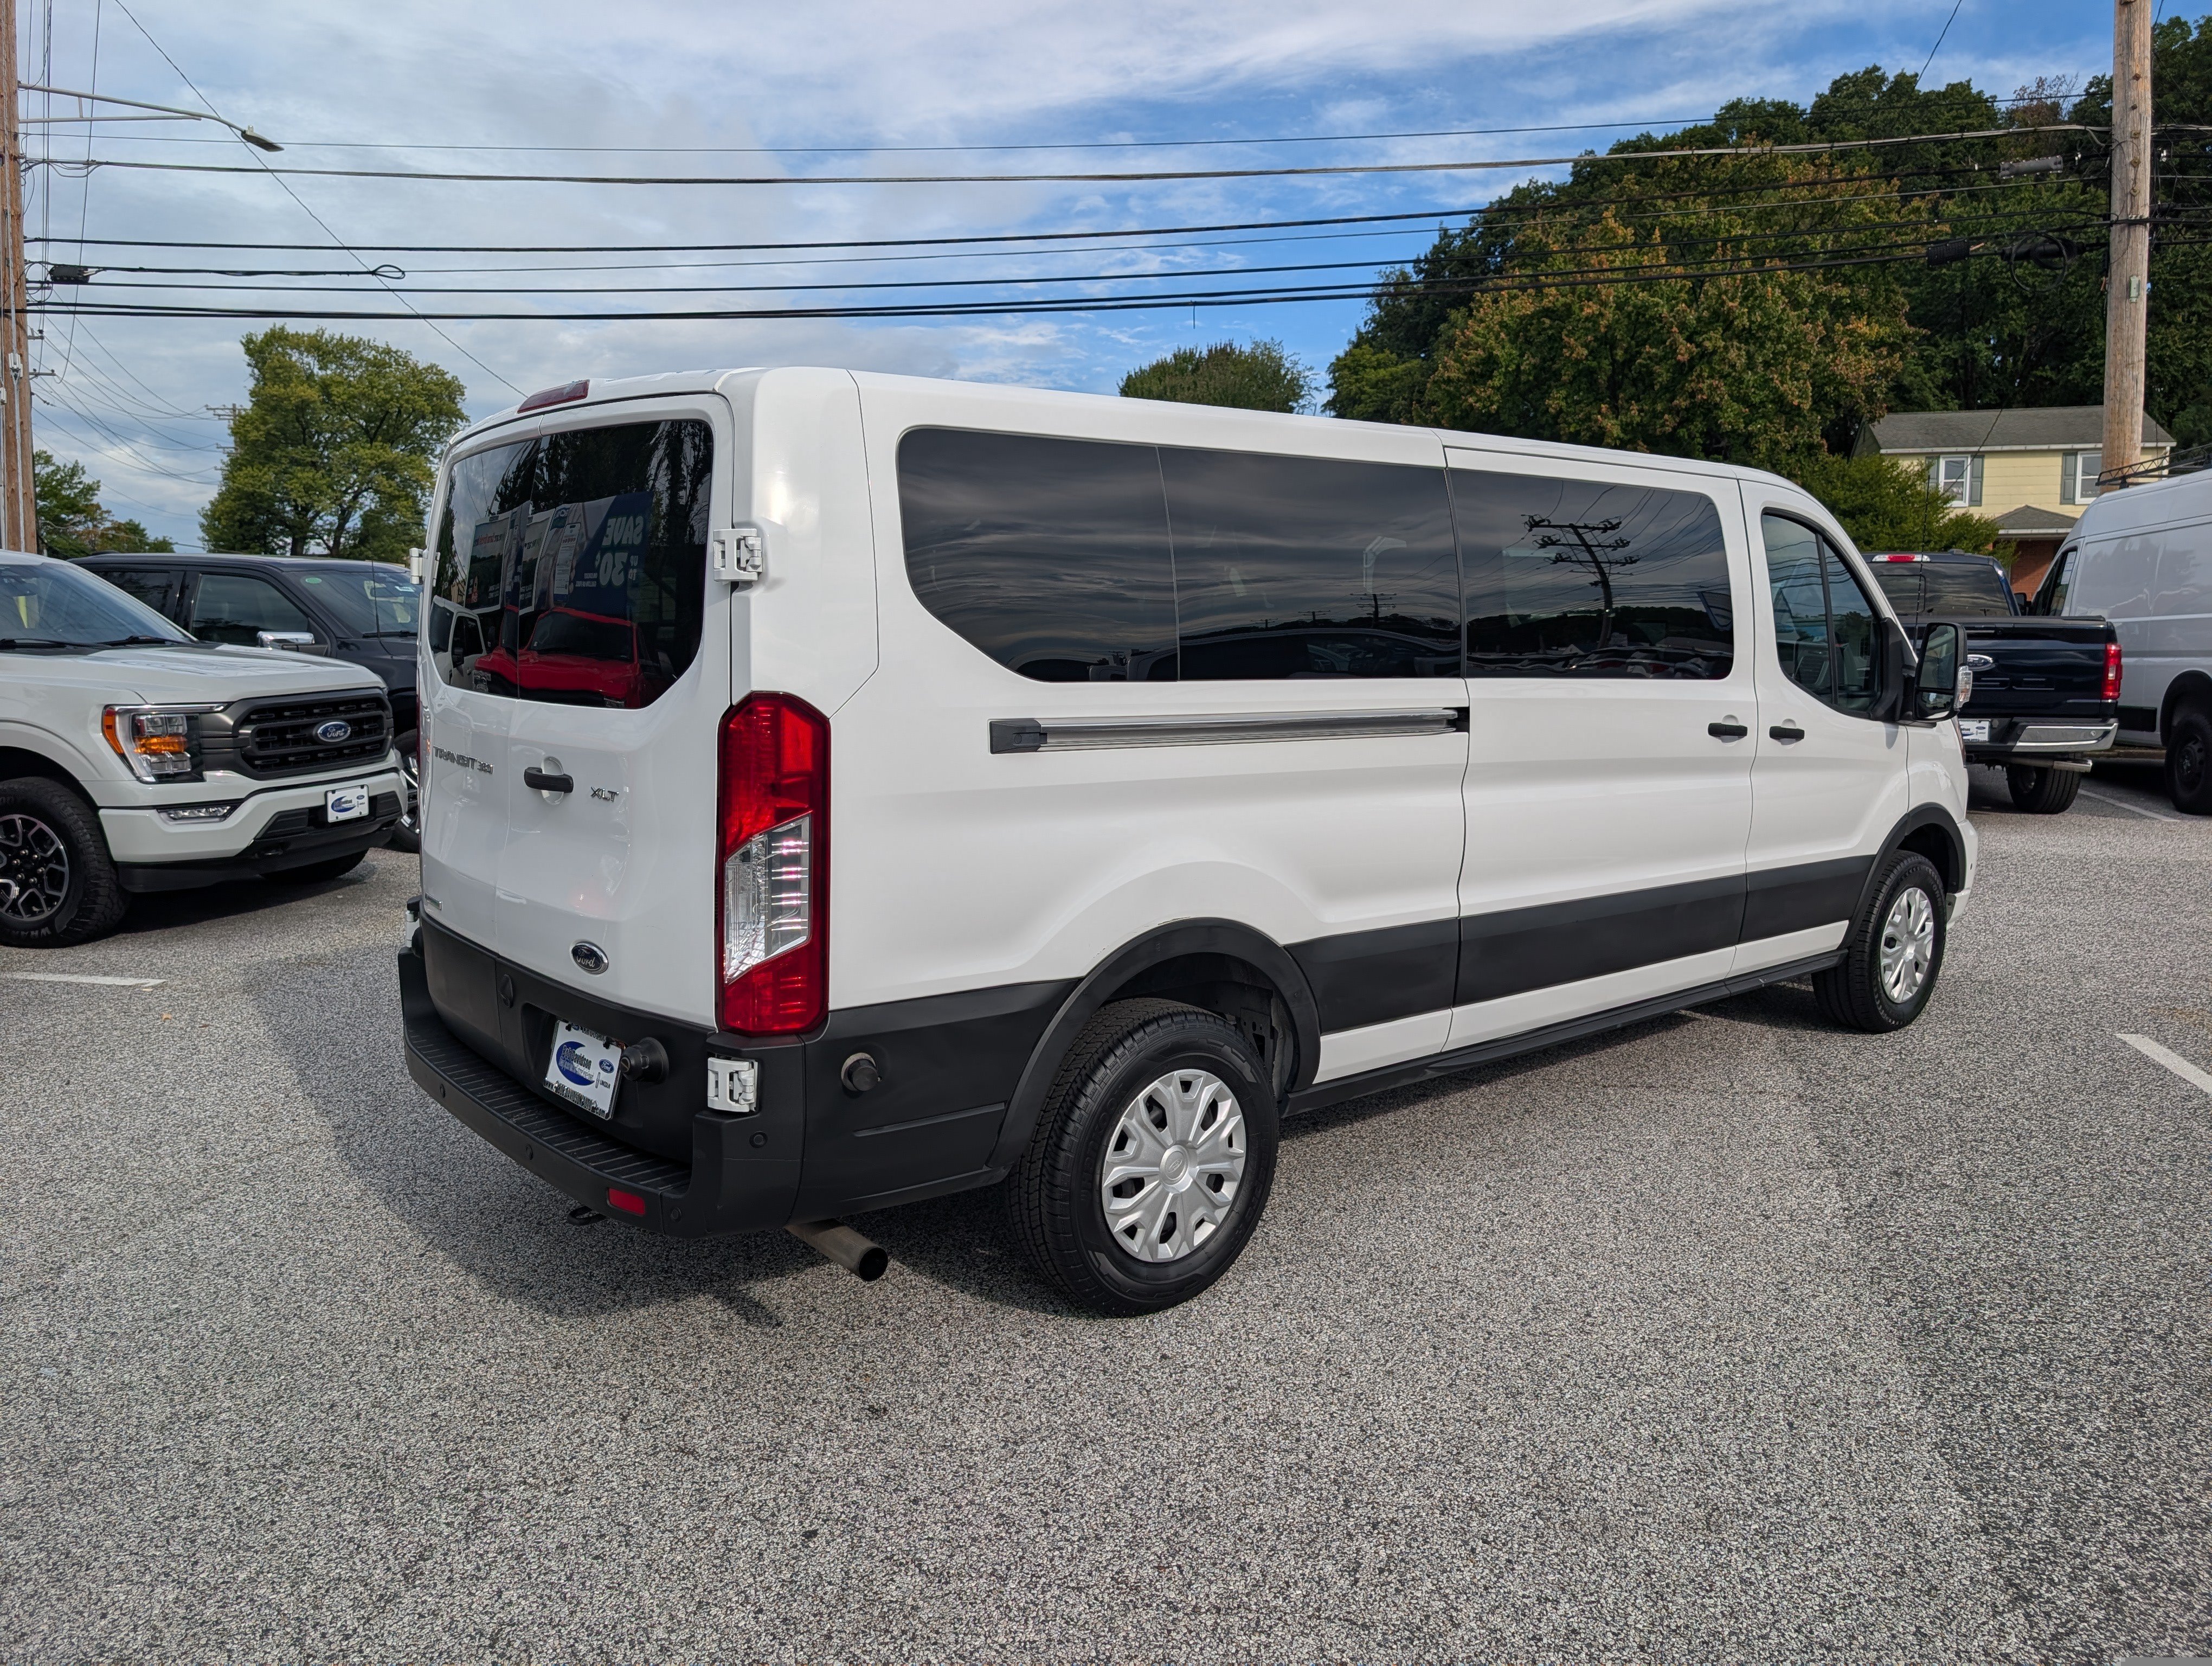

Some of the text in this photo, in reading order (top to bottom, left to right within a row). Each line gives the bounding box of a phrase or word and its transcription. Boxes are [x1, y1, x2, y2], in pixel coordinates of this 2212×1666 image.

[326, 725, 345, 738] Ford
[433, 745, 478, 770] TRANSIT
[591, 787, 619, 802] XLT
[576, 946, 596, 967] Ford
[600, 1060, 613, 1072] Ford
[600, 1079, 611, 1089] LINCOLN
